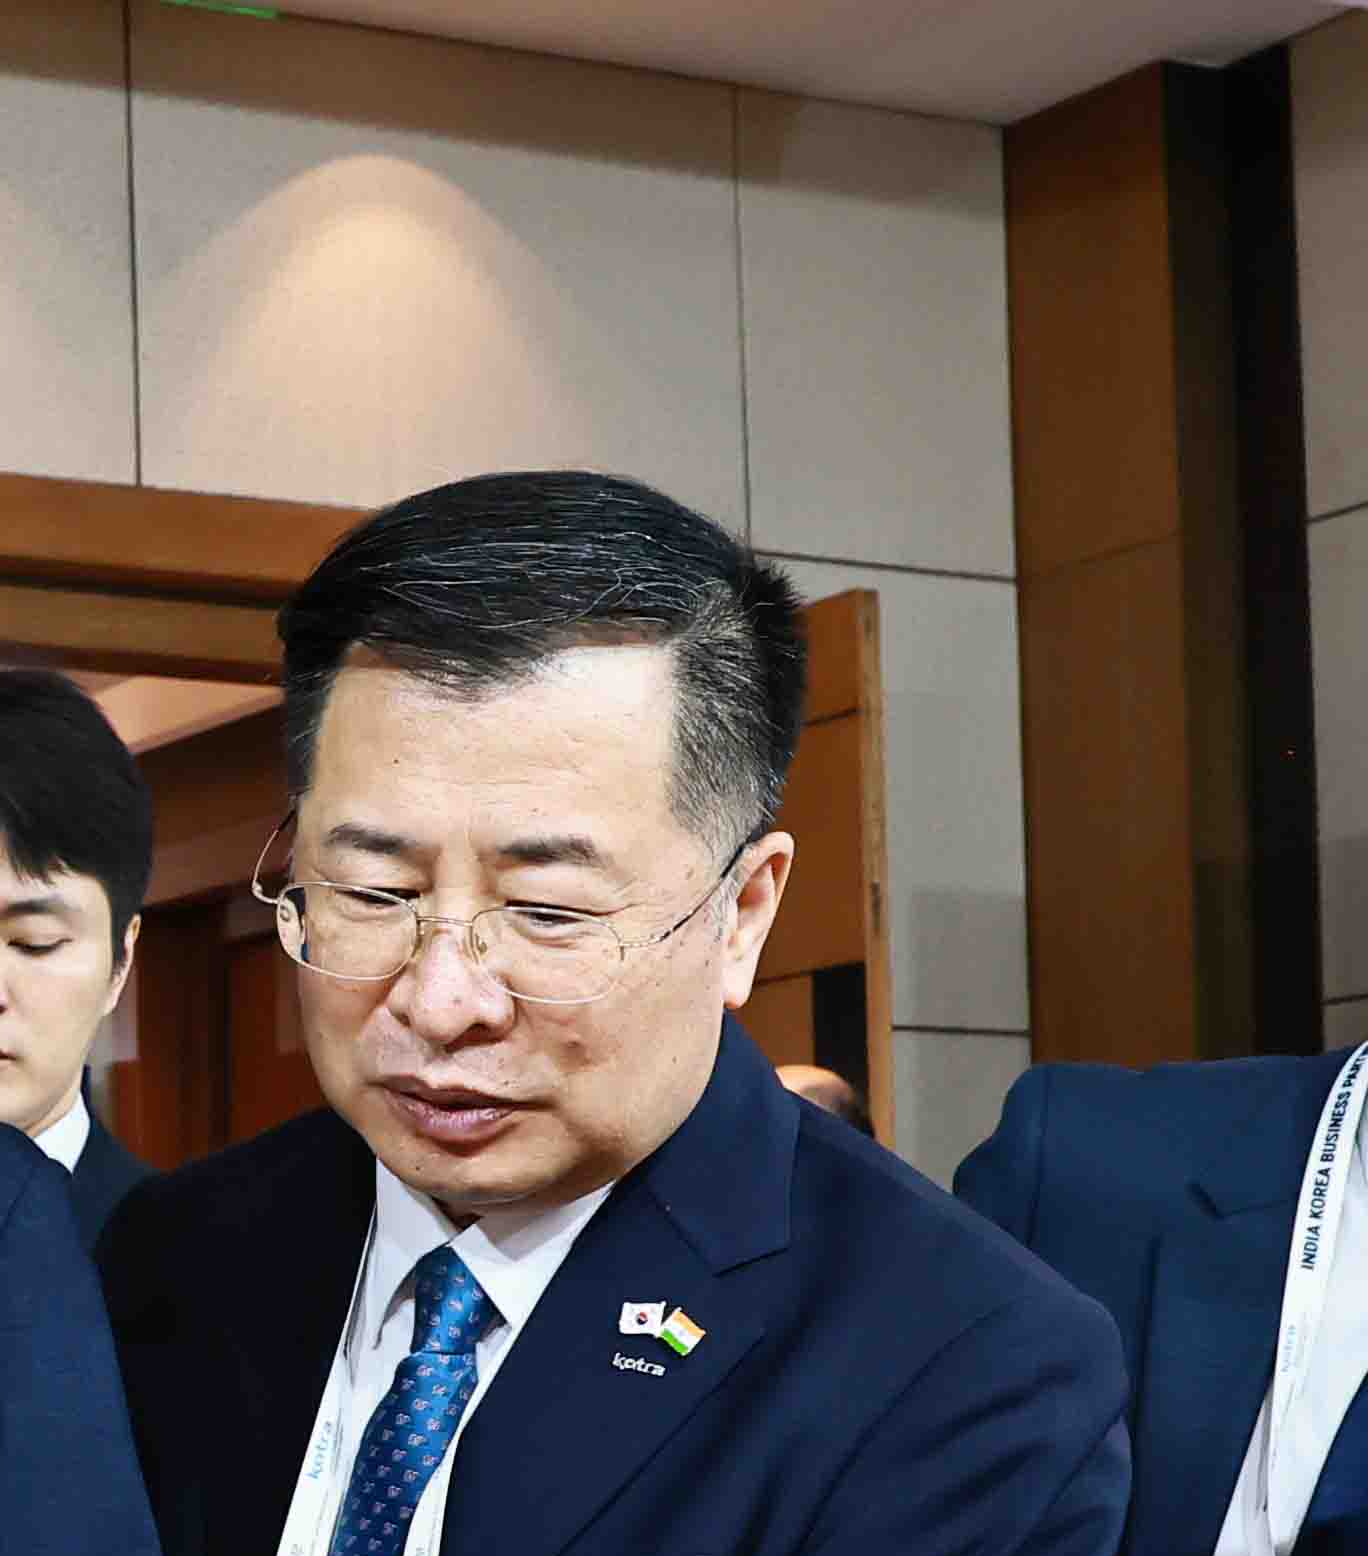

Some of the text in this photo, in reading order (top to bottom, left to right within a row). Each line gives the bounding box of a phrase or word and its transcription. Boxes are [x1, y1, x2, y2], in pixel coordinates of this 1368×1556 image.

[1320, 1092, 1351, 1163] BUSINESS
[1310, 1167, 1331, 1219] KOREA
[1300, 1225, 1321, 1271] INDIA
[612, 1352, 666, 1377] kotra
[305, 1419, 333, 1481] kotra
